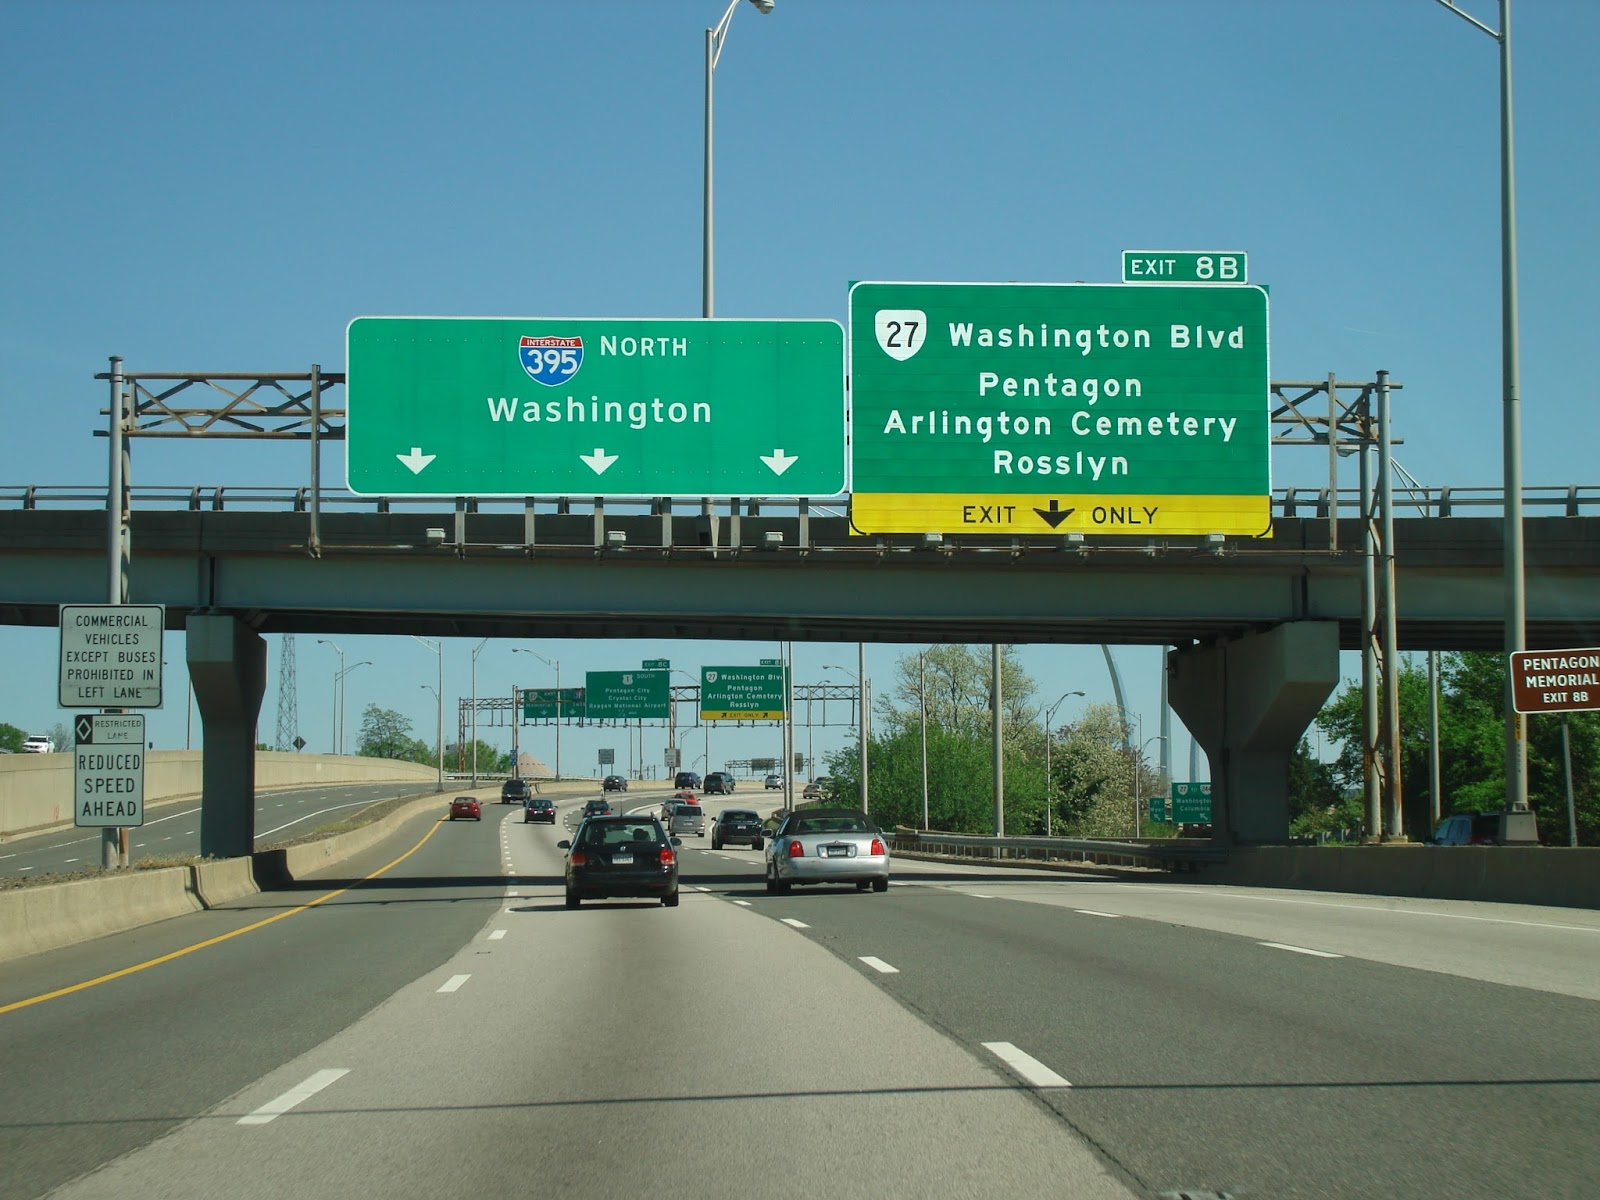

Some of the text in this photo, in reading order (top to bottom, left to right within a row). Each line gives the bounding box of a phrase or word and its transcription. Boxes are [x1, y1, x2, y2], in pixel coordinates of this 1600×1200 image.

[1131, 256, 1239, 279] EXIT 8B
[526, 337, 577, 347] INTERSTATE
[886, 321, 919, 348] 27
[949, 322, 1245, 356] Washington Blvd
[600, 336, 687, 357] NORTH
[526, 349, 578, 375] 395
[979, 372, 1142, 405] Pentagon
[487, 396, 711, 429] Washington
[883, 409, 1237, 443] Arlington Cemetery
[993, 450, 1128, 481] Rosslyn
[962, 506, 1158, 525] EXIT ONLY
[76, 615, 148, 627] COMMERCIAL
[85, 633, 139, 645] VEHICLES
[66, 651, 156, 663] EXCEPT BUSES
[1523, 656, 1600, 671] PENTAGON
[67, 669, 154, 680] PROHIBITED IN
[707, 673, 716, 681] 27
[721, 674, 765, 682] Washington
[1525, 673, 1600, 688] MEMORIAL
[78, 686, 142, 699] LEFT LANE
[727, 685, 763, 693] Pentagon
[707, 693, 783, 701] Arlington Cemetery
[1543, 691, 1589, 703] EXIT 8B
[729, 701, 759, 709] Rosslyn
[95, 720, 142, 728] RESTRICTED
[79, 754, 140, 770] REDUCED
[84, 778, 135, 793] SPEED
[82, 801, 137, 816] AHEAD
